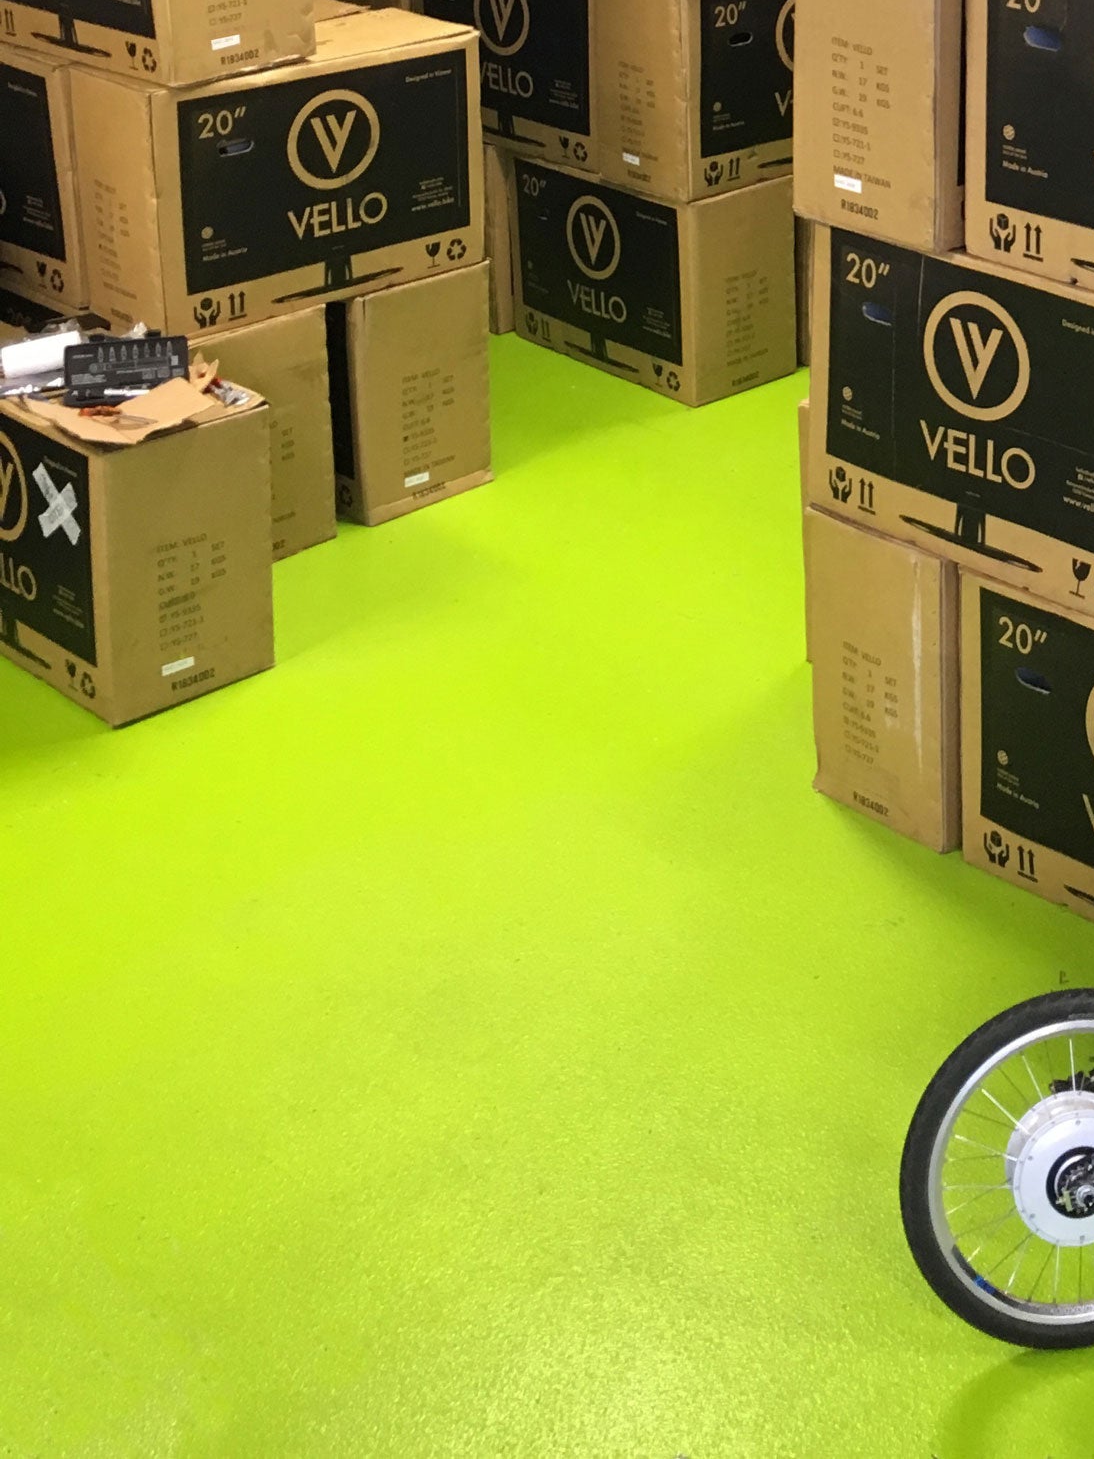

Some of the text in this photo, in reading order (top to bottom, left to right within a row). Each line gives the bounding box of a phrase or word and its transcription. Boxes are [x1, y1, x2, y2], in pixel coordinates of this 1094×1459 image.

[714, 0, 746, 27] 20"
[198, 106, 246, 140] 20"
[523, 174, 547, 197] 20"
[288, 192, 388, 240] VELLO
[846, 253, 890, 289] 20"
[567, 279, 627, 324] VELLO
[920, 419, 1036, 489] VELLO
[998, 616, 1048, 654] 20"
